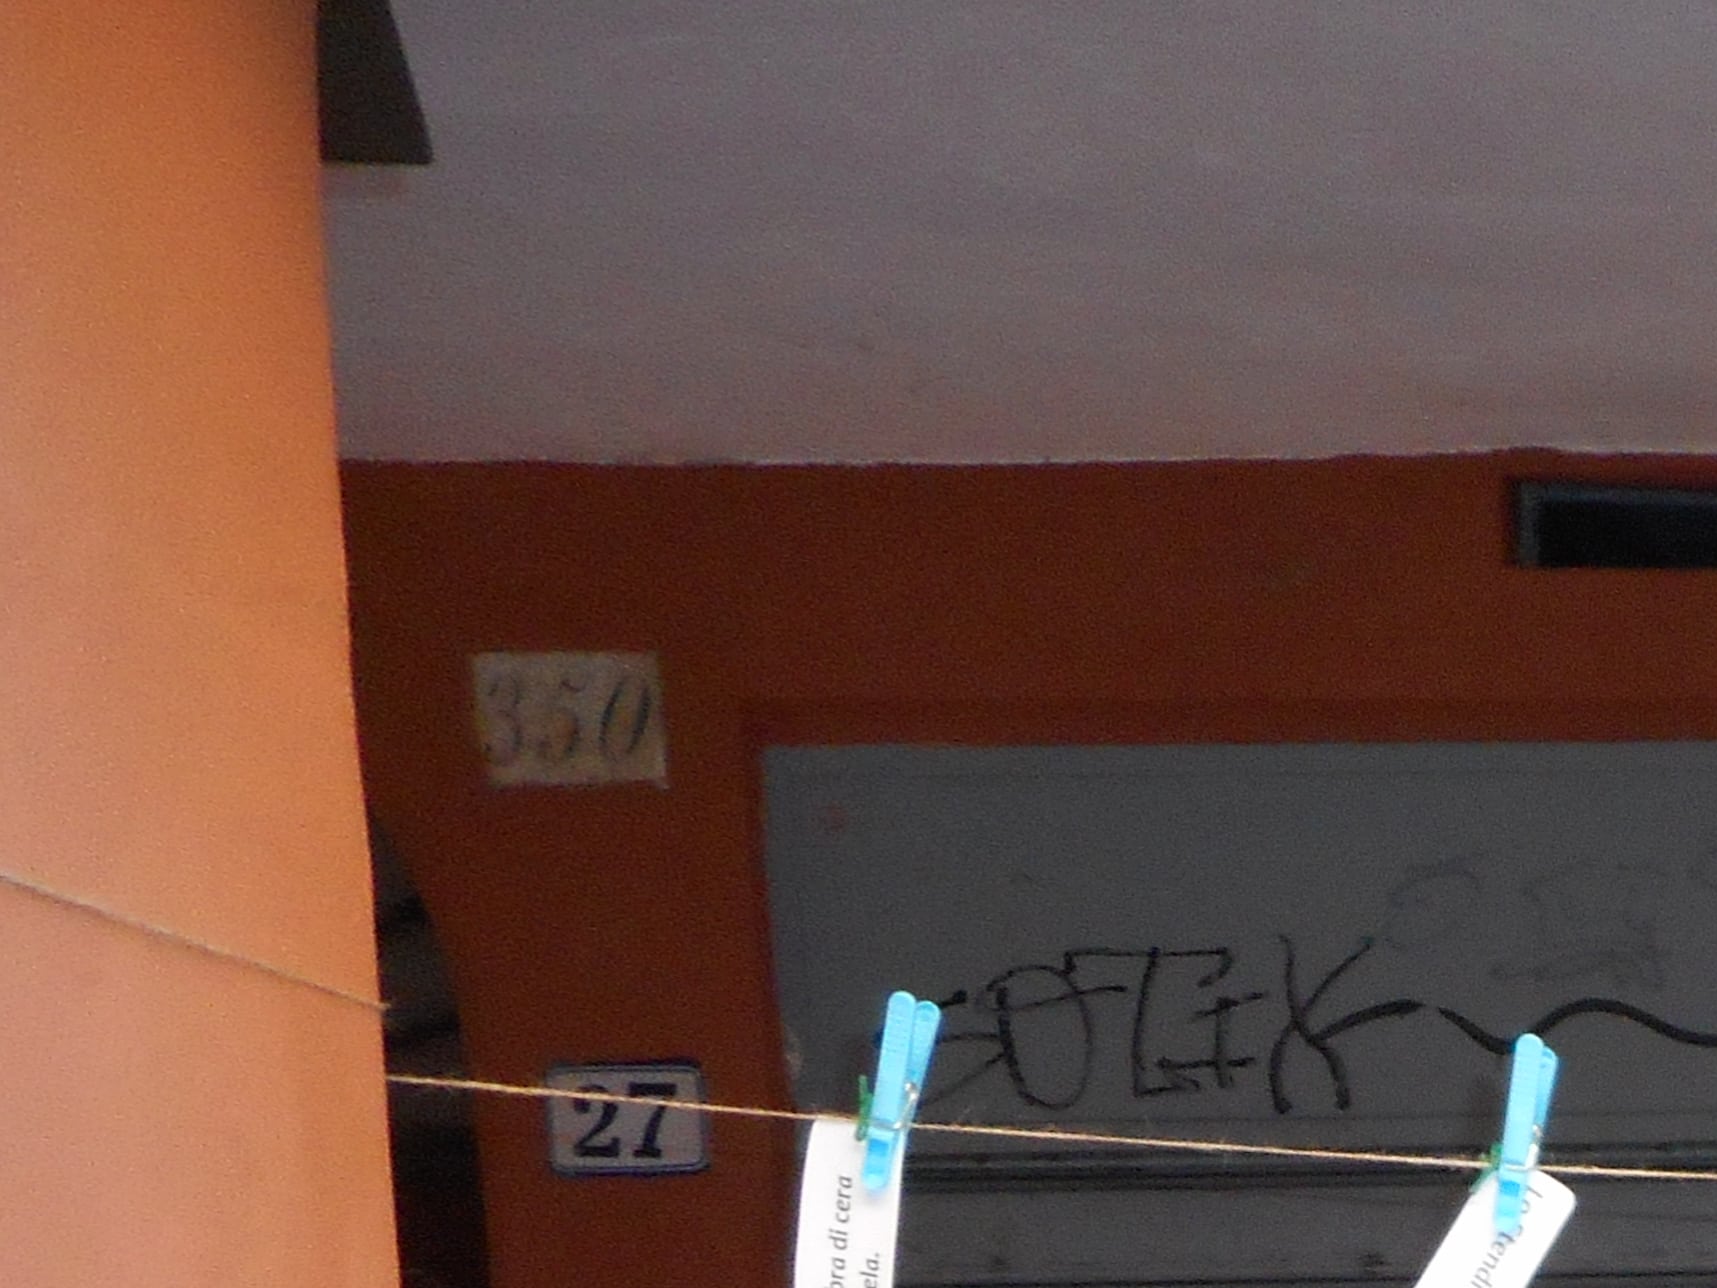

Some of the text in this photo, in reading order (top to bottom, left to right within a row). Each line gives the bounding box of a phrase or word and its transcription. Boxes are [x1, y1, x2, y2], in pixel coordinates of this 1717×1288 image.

[573, 1082, 677, 1158] 27
[835, 1175, 853, 1224] cera
[828, 1228, 849, 1251] di
